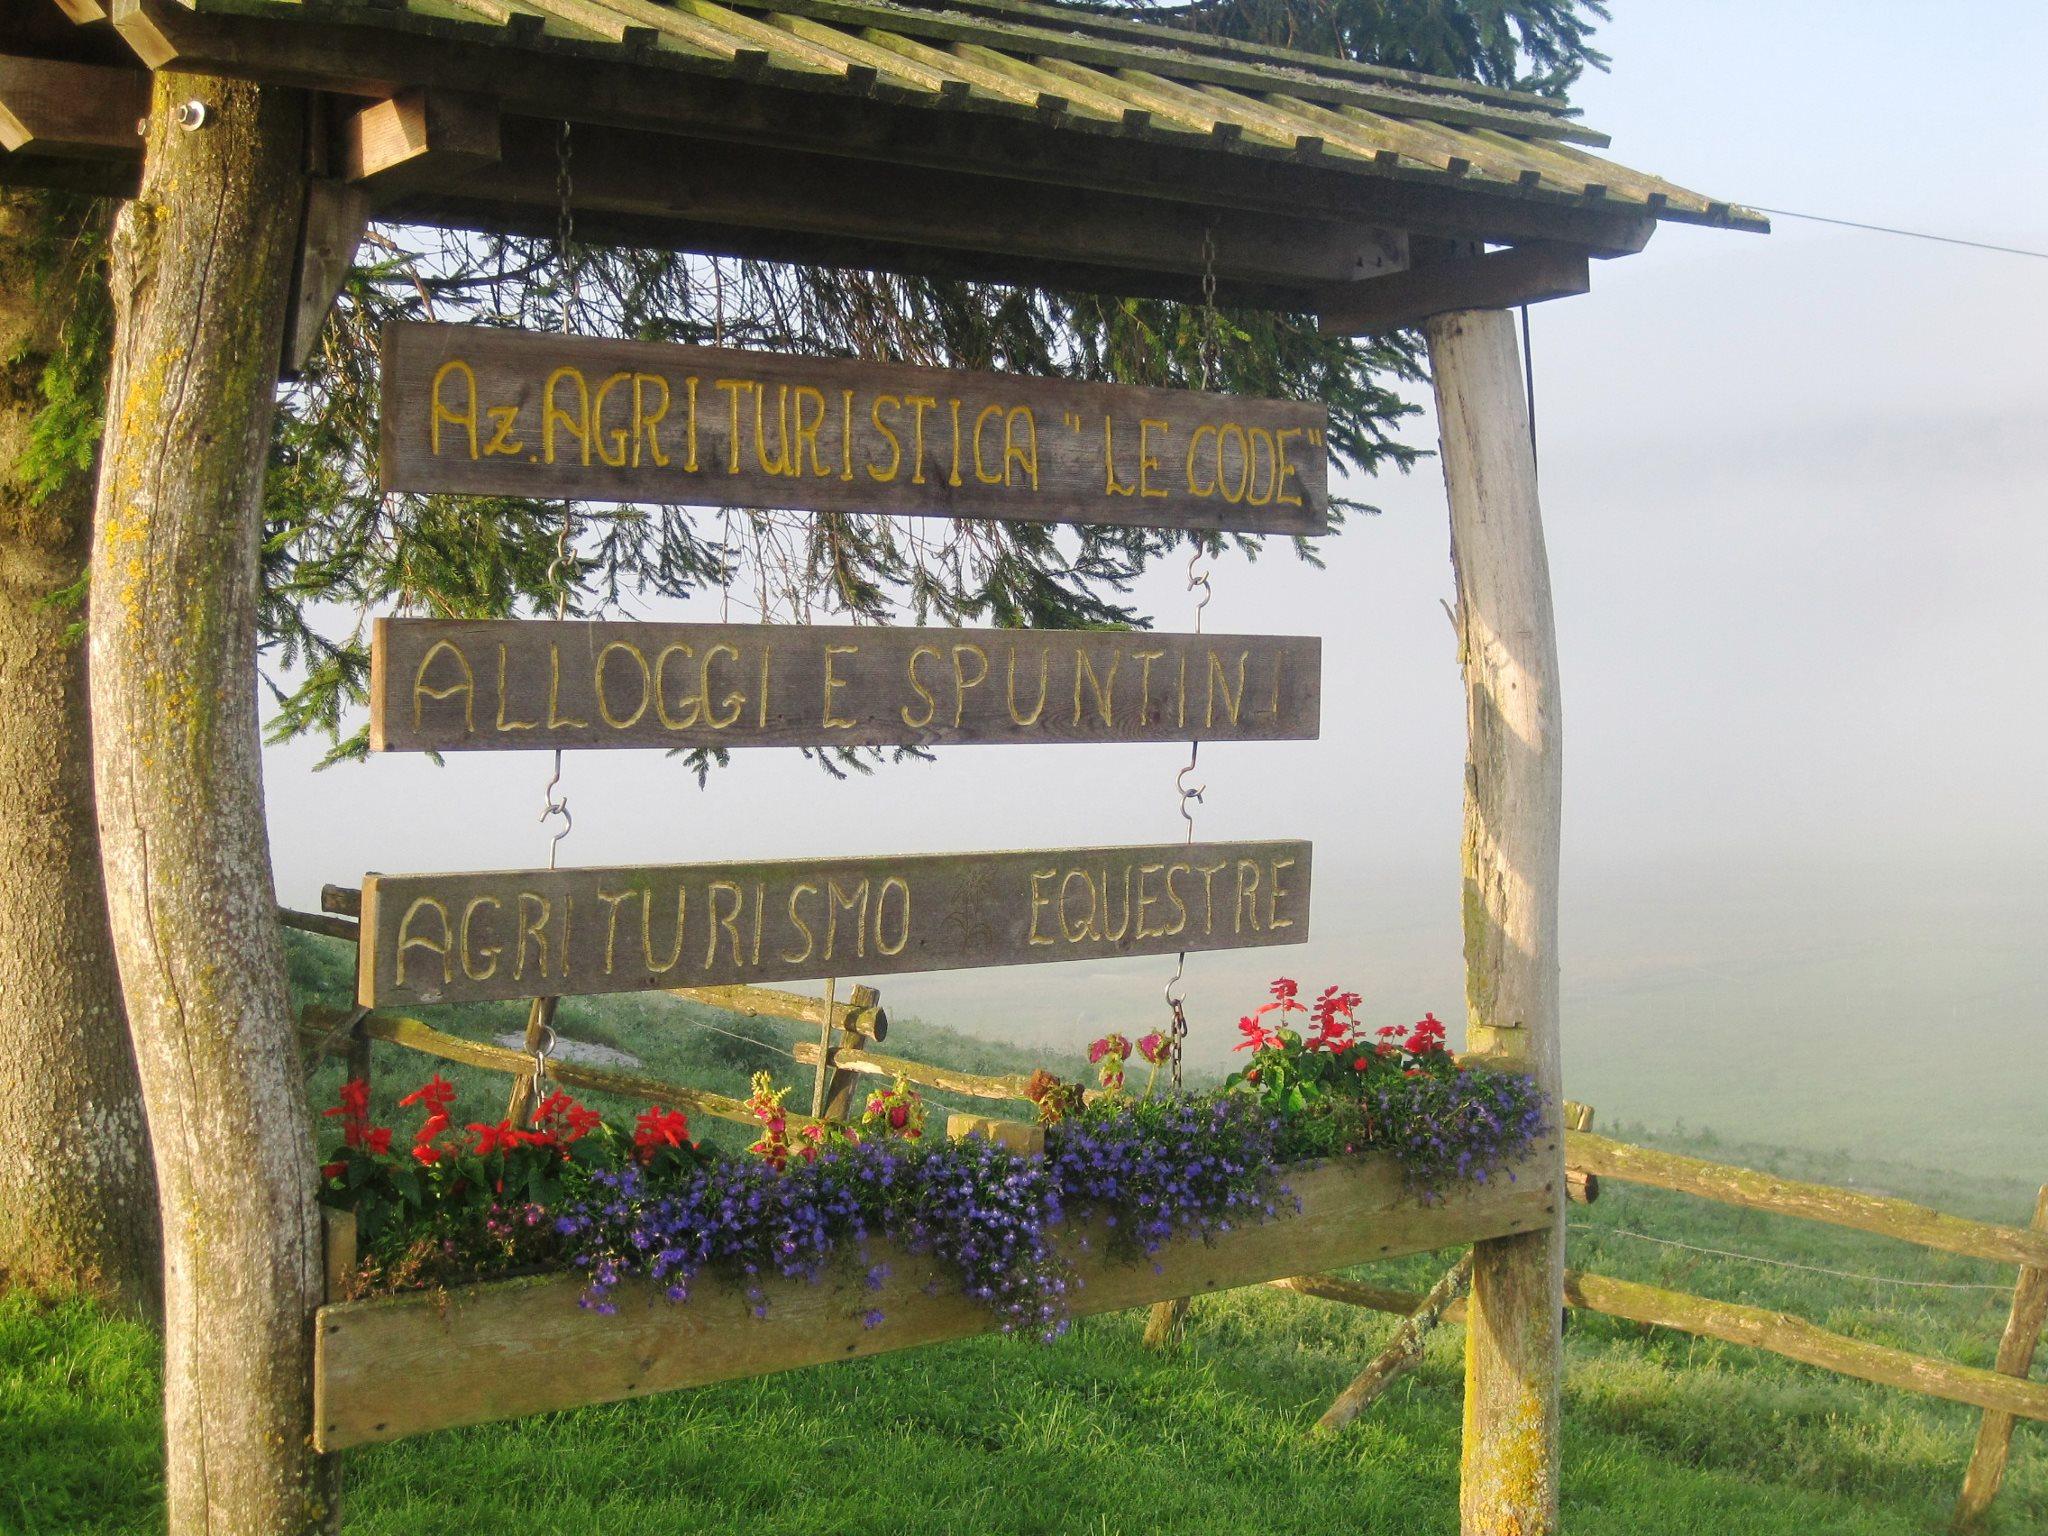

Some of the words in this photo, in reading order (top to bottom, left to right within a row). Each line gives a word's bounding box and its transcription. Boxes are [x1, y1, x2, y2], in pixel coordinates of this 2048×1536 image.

[431, 359, 539, 464] Az.
[542, 365, 1039, 492] AGRITURISTICA
[412, 638, 771, 734] ALLOGGI
[822, 644, 859, 730] E
[901, 643, 1287, 729] SPUNTINI
[394, 876, 911, 986] AGRITURISMO
[1029, 856, 1296, 946] EQUESTRE
